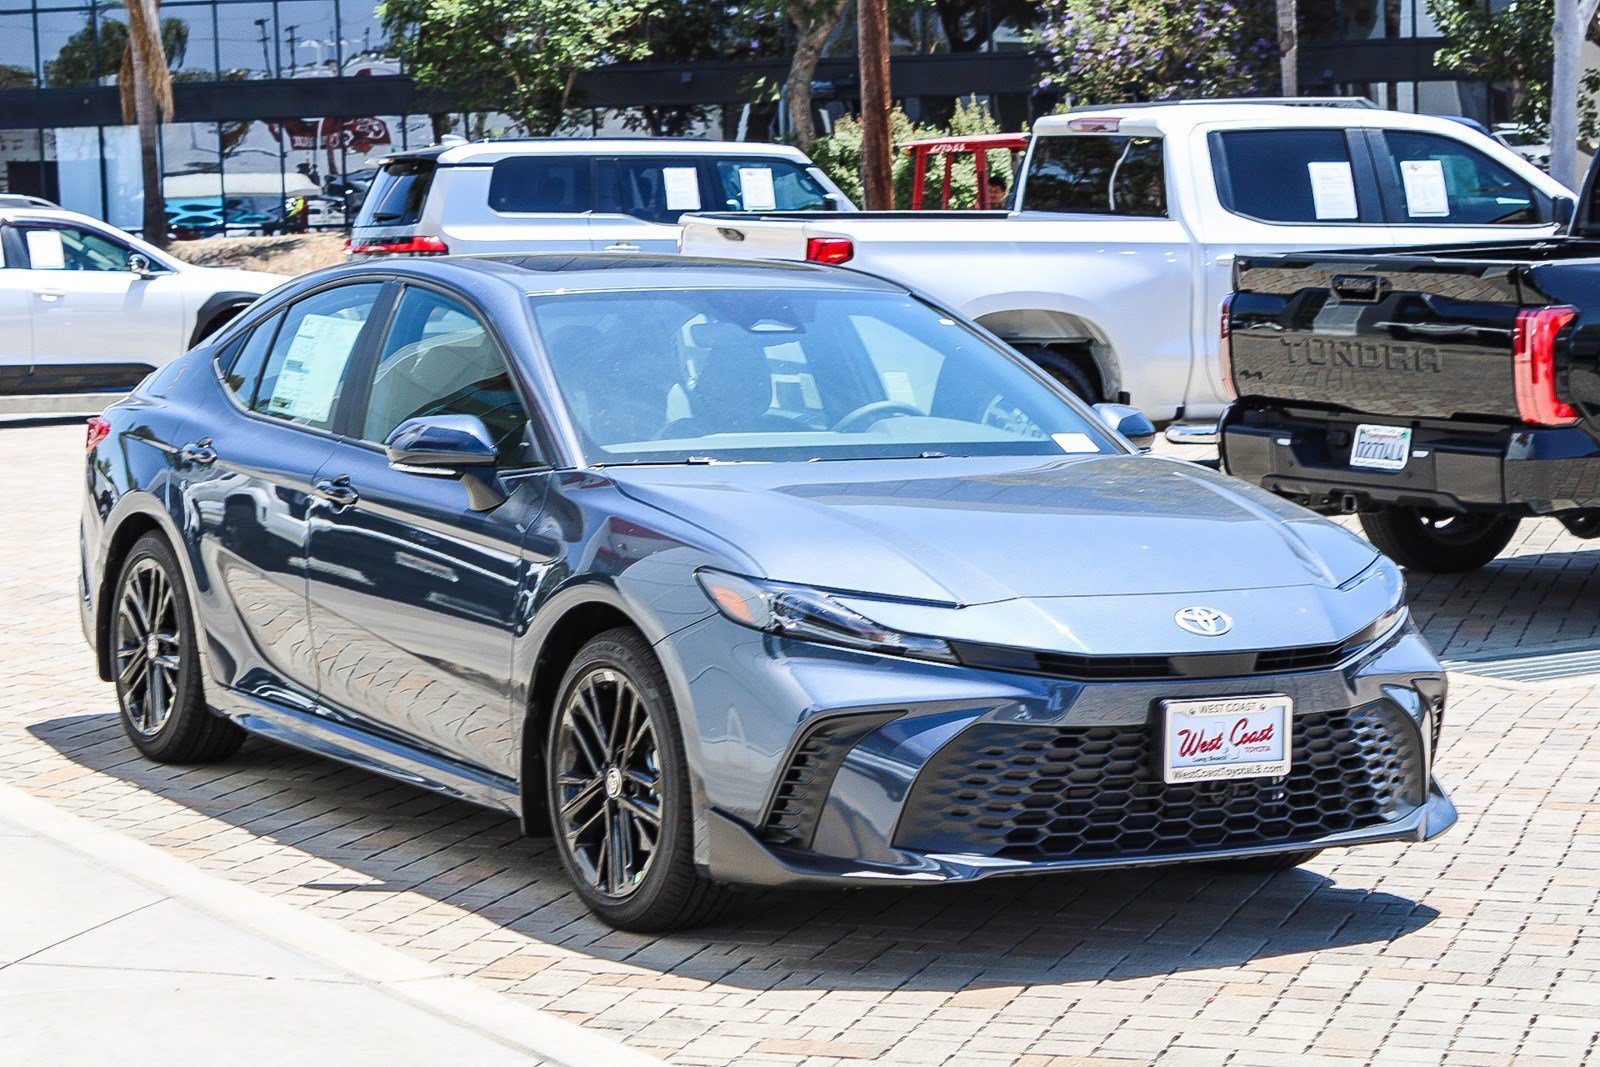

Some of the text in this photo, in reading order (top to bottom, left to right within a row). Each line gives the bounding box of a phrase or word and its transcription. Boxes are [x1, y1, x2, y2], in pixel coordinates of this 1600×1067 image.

[1280, 337, 1441, 373] TUNDRA
[1199, 702, 1257, 714] WEST COAST
[1177, 718, 1275, 757] West Coast
